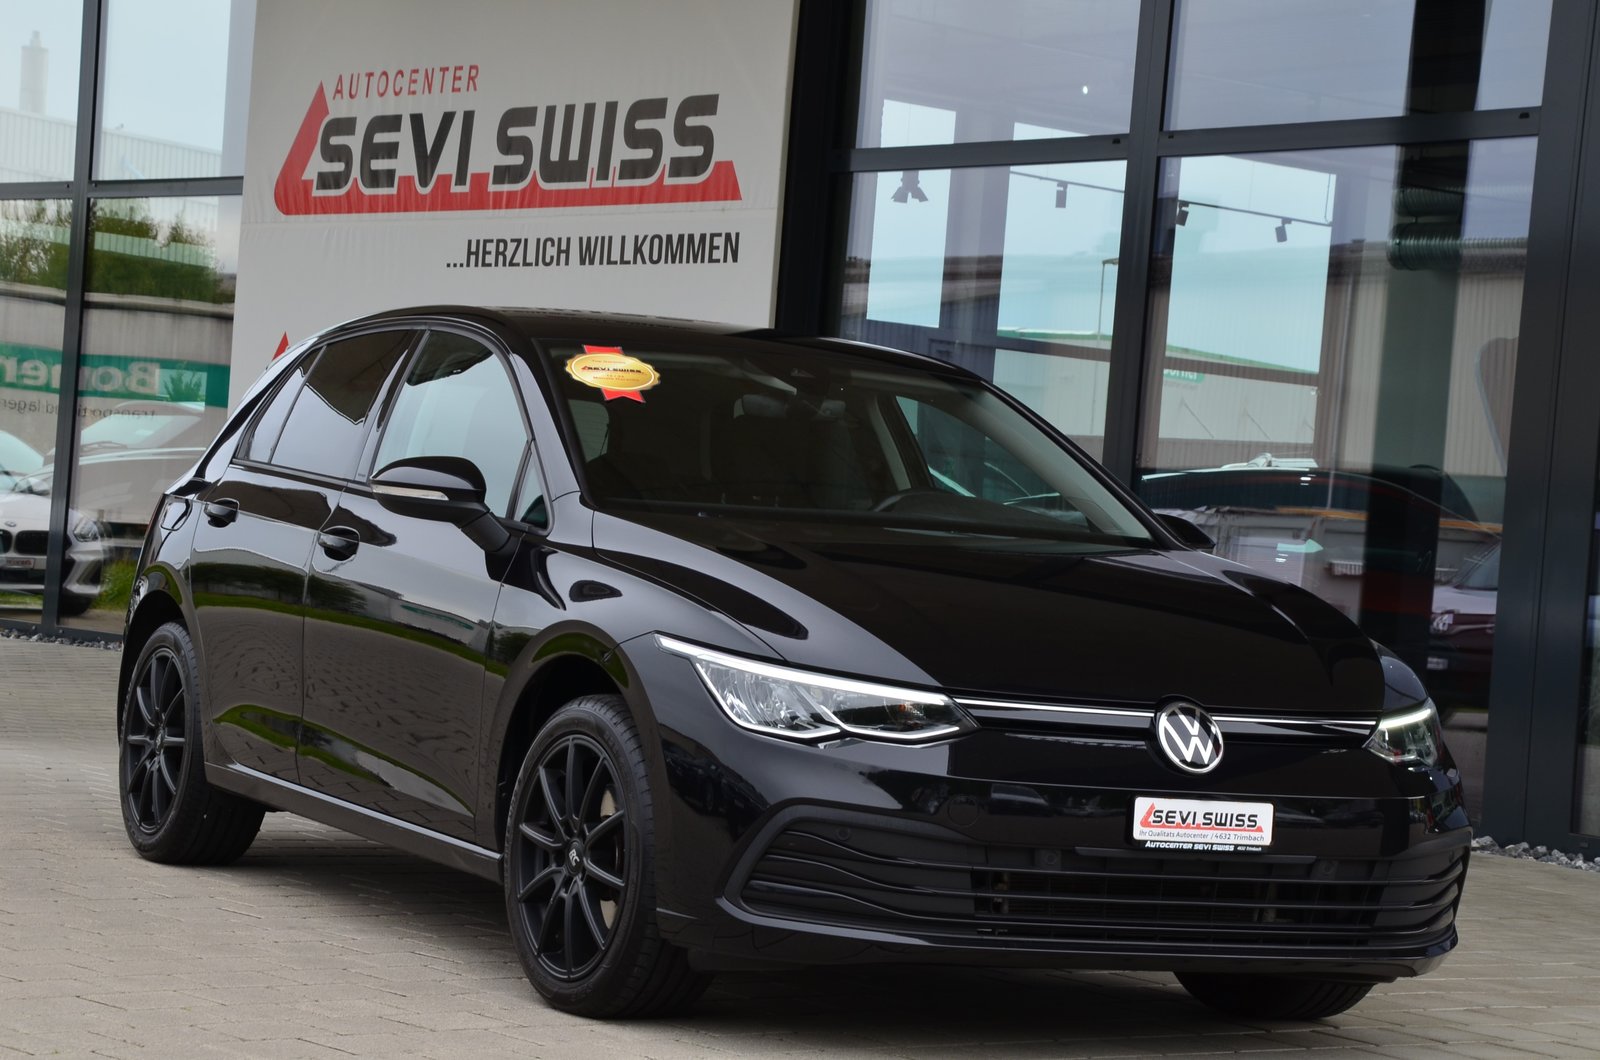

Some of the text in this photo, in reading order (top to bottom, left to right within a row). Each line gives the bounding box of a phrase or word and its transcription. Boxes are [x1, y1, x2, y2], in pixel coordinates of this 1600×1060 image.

[333, 64, 480, 101] AUTOCENTER
[315, 93, 720, 192] SEVI SWISS
[446, 231, 740, 269] ...HERZLICH WILLKOMMEN
[1152, 809, 1258, 828] SEVI SWISS
[1176, 831, 1209, 839] Autocenter
[1214, 832, 1231, 840] 4632
[1233, 833, 1265, 842] Trimbach
[1193, 842, 1212, 850] SEVI
